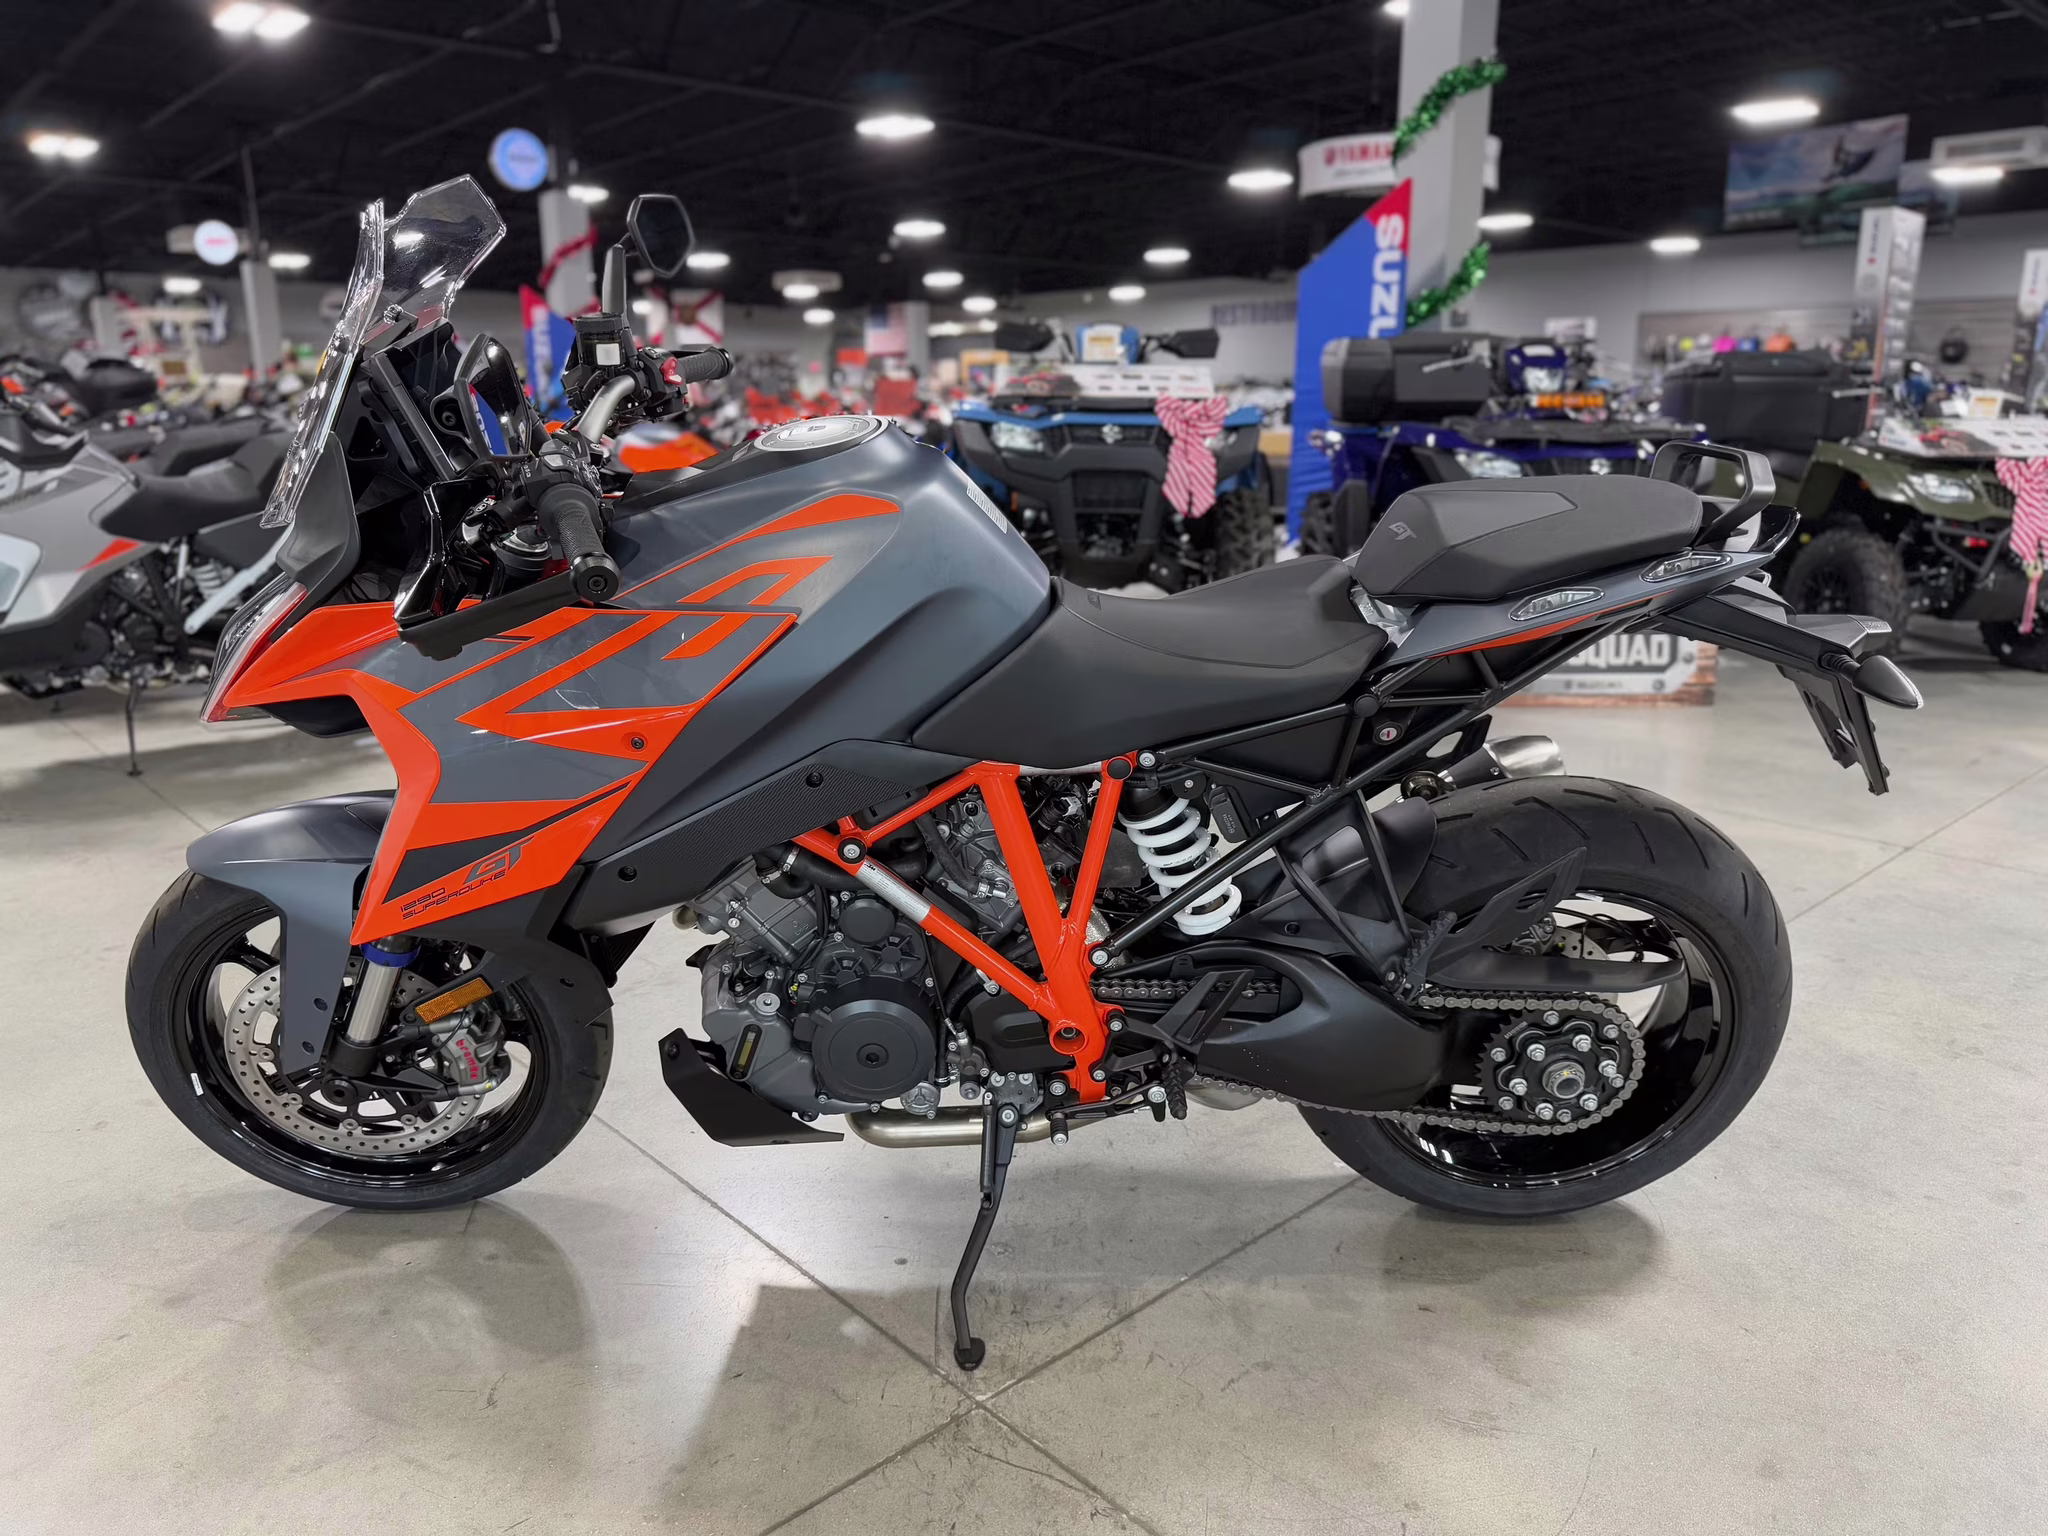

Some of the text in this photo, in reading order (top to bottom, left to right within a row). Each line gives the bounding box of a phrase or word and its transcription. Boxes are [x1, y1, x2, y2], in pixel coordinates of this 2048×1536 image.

[463, 836, 534, 885] GT
[400, 887, 446, 912] 1290
[402, 869, 506, 920] SUPERDUKE
